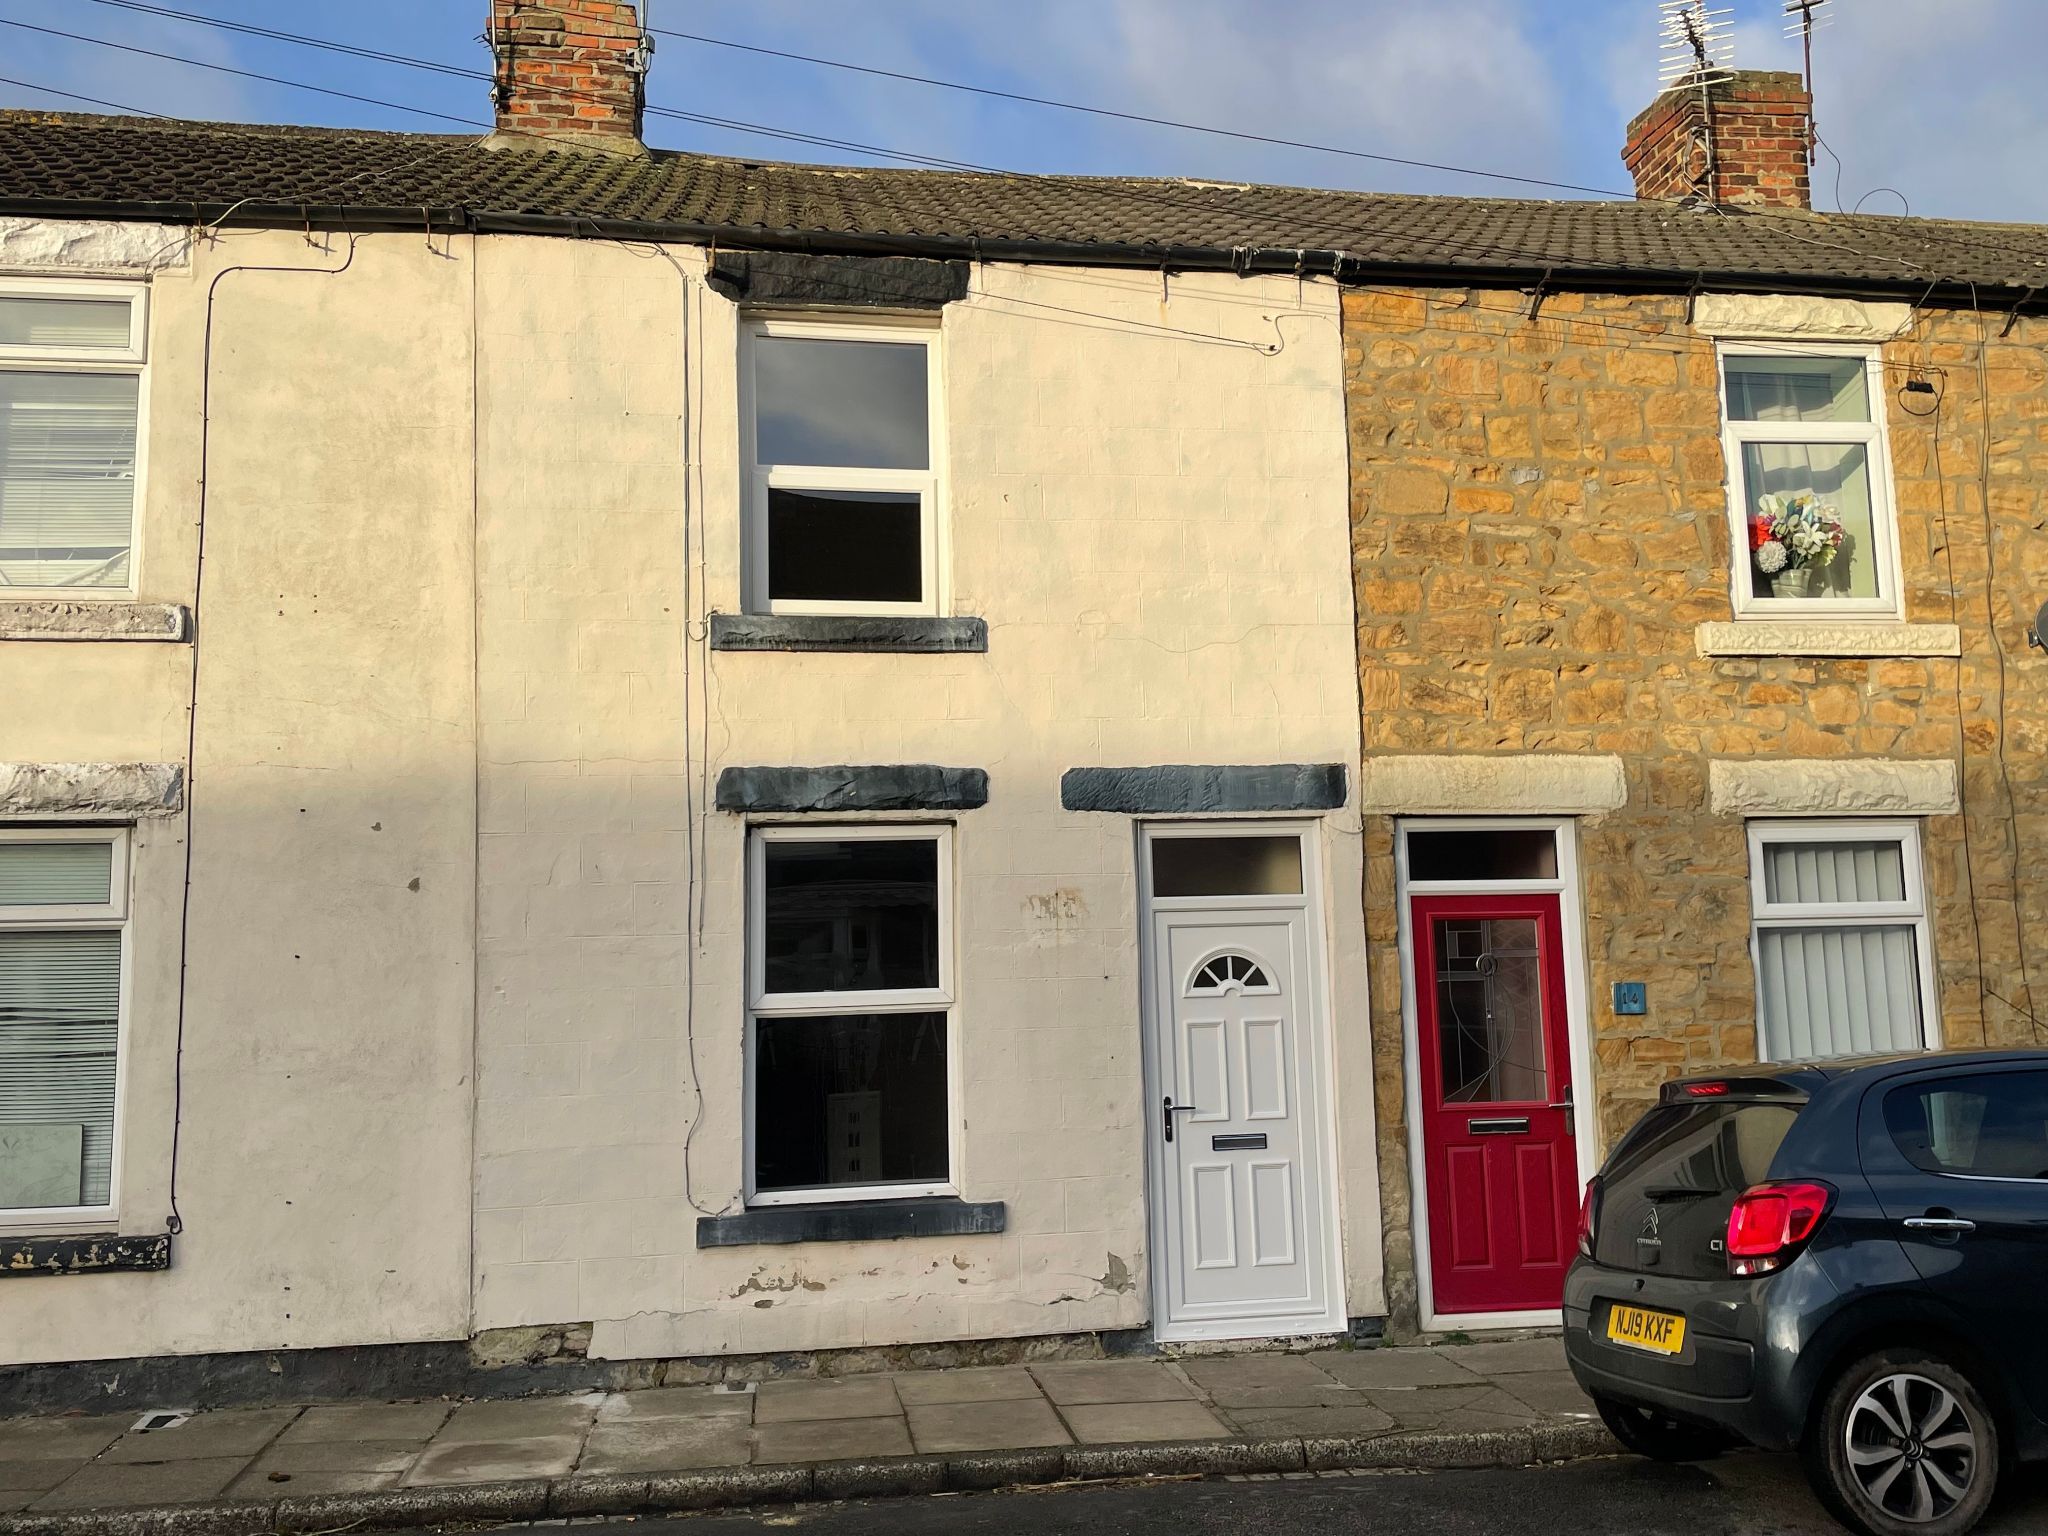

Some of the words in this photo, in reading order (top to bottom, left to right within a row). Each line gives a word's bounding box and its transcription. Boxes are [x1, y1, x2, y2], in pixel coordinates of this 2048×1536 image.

[1622, 992, 1639, 1005] 14
[1616, 1310, 1642, 1337] NJ19
[1645, 1315, 1675, 1343] KXF
